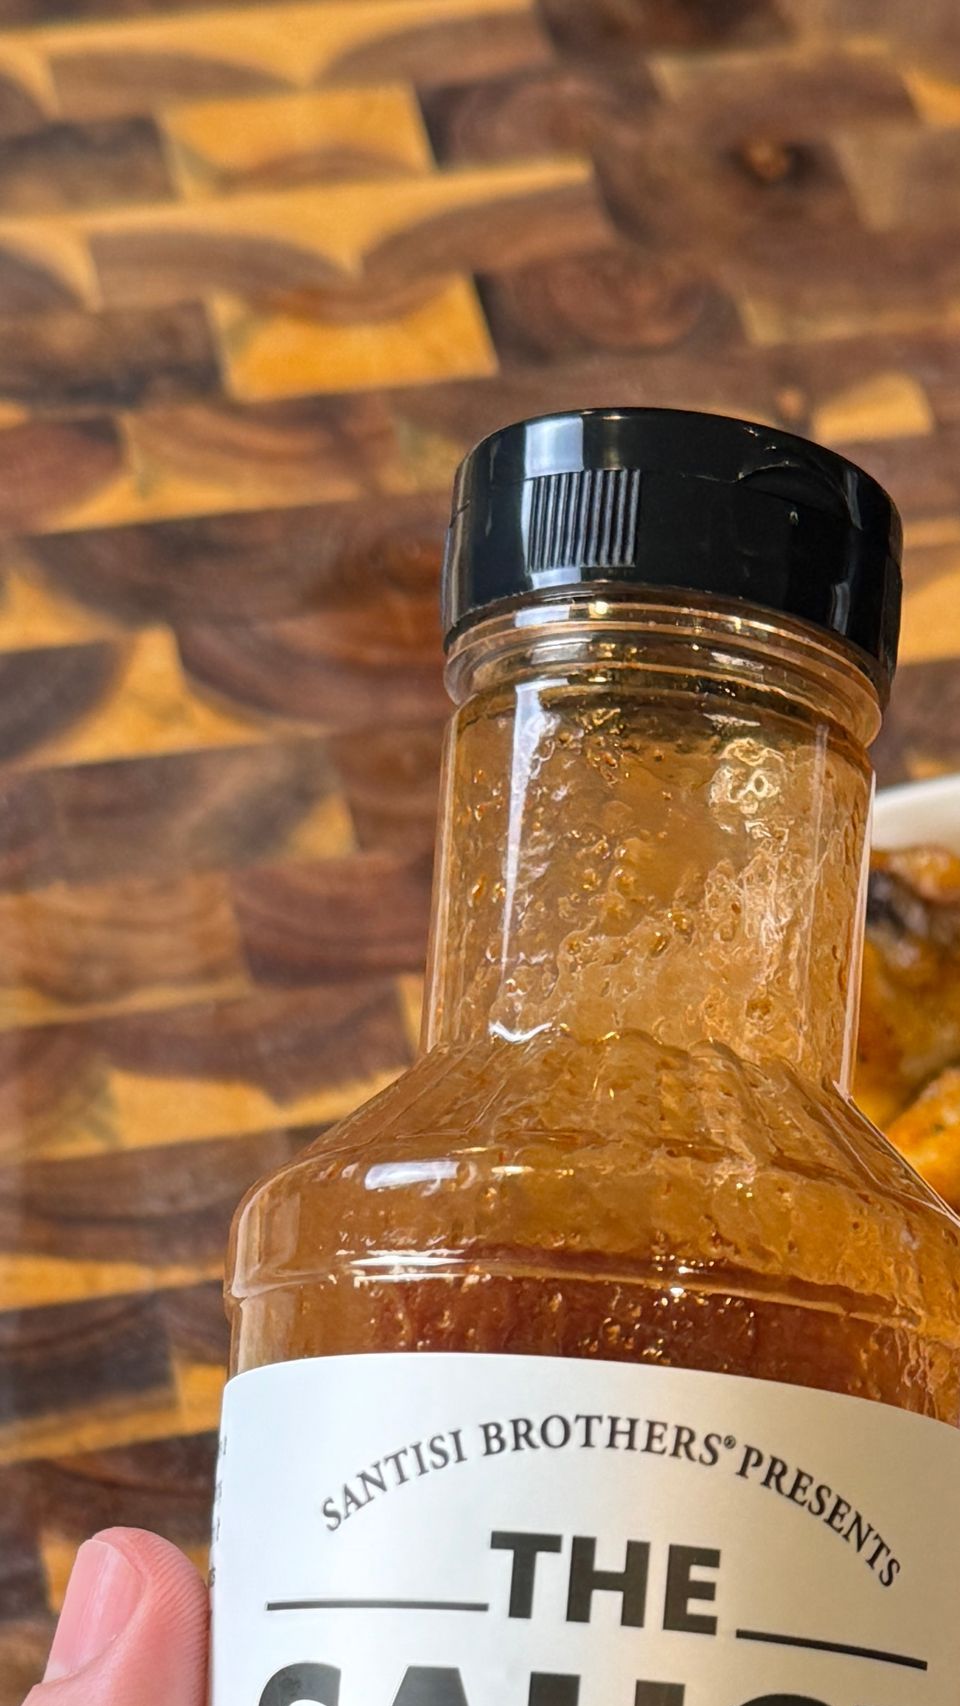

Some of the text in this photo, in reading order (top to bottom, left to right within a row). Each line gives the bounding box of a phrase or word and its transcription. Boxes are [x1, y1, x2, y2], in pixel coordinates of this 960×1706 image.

[321, 1430, 467, 1532] SANTISI
[735, 1444, 901, 1588] PRESENTS
[490, 1530, 722, 1637] THE
